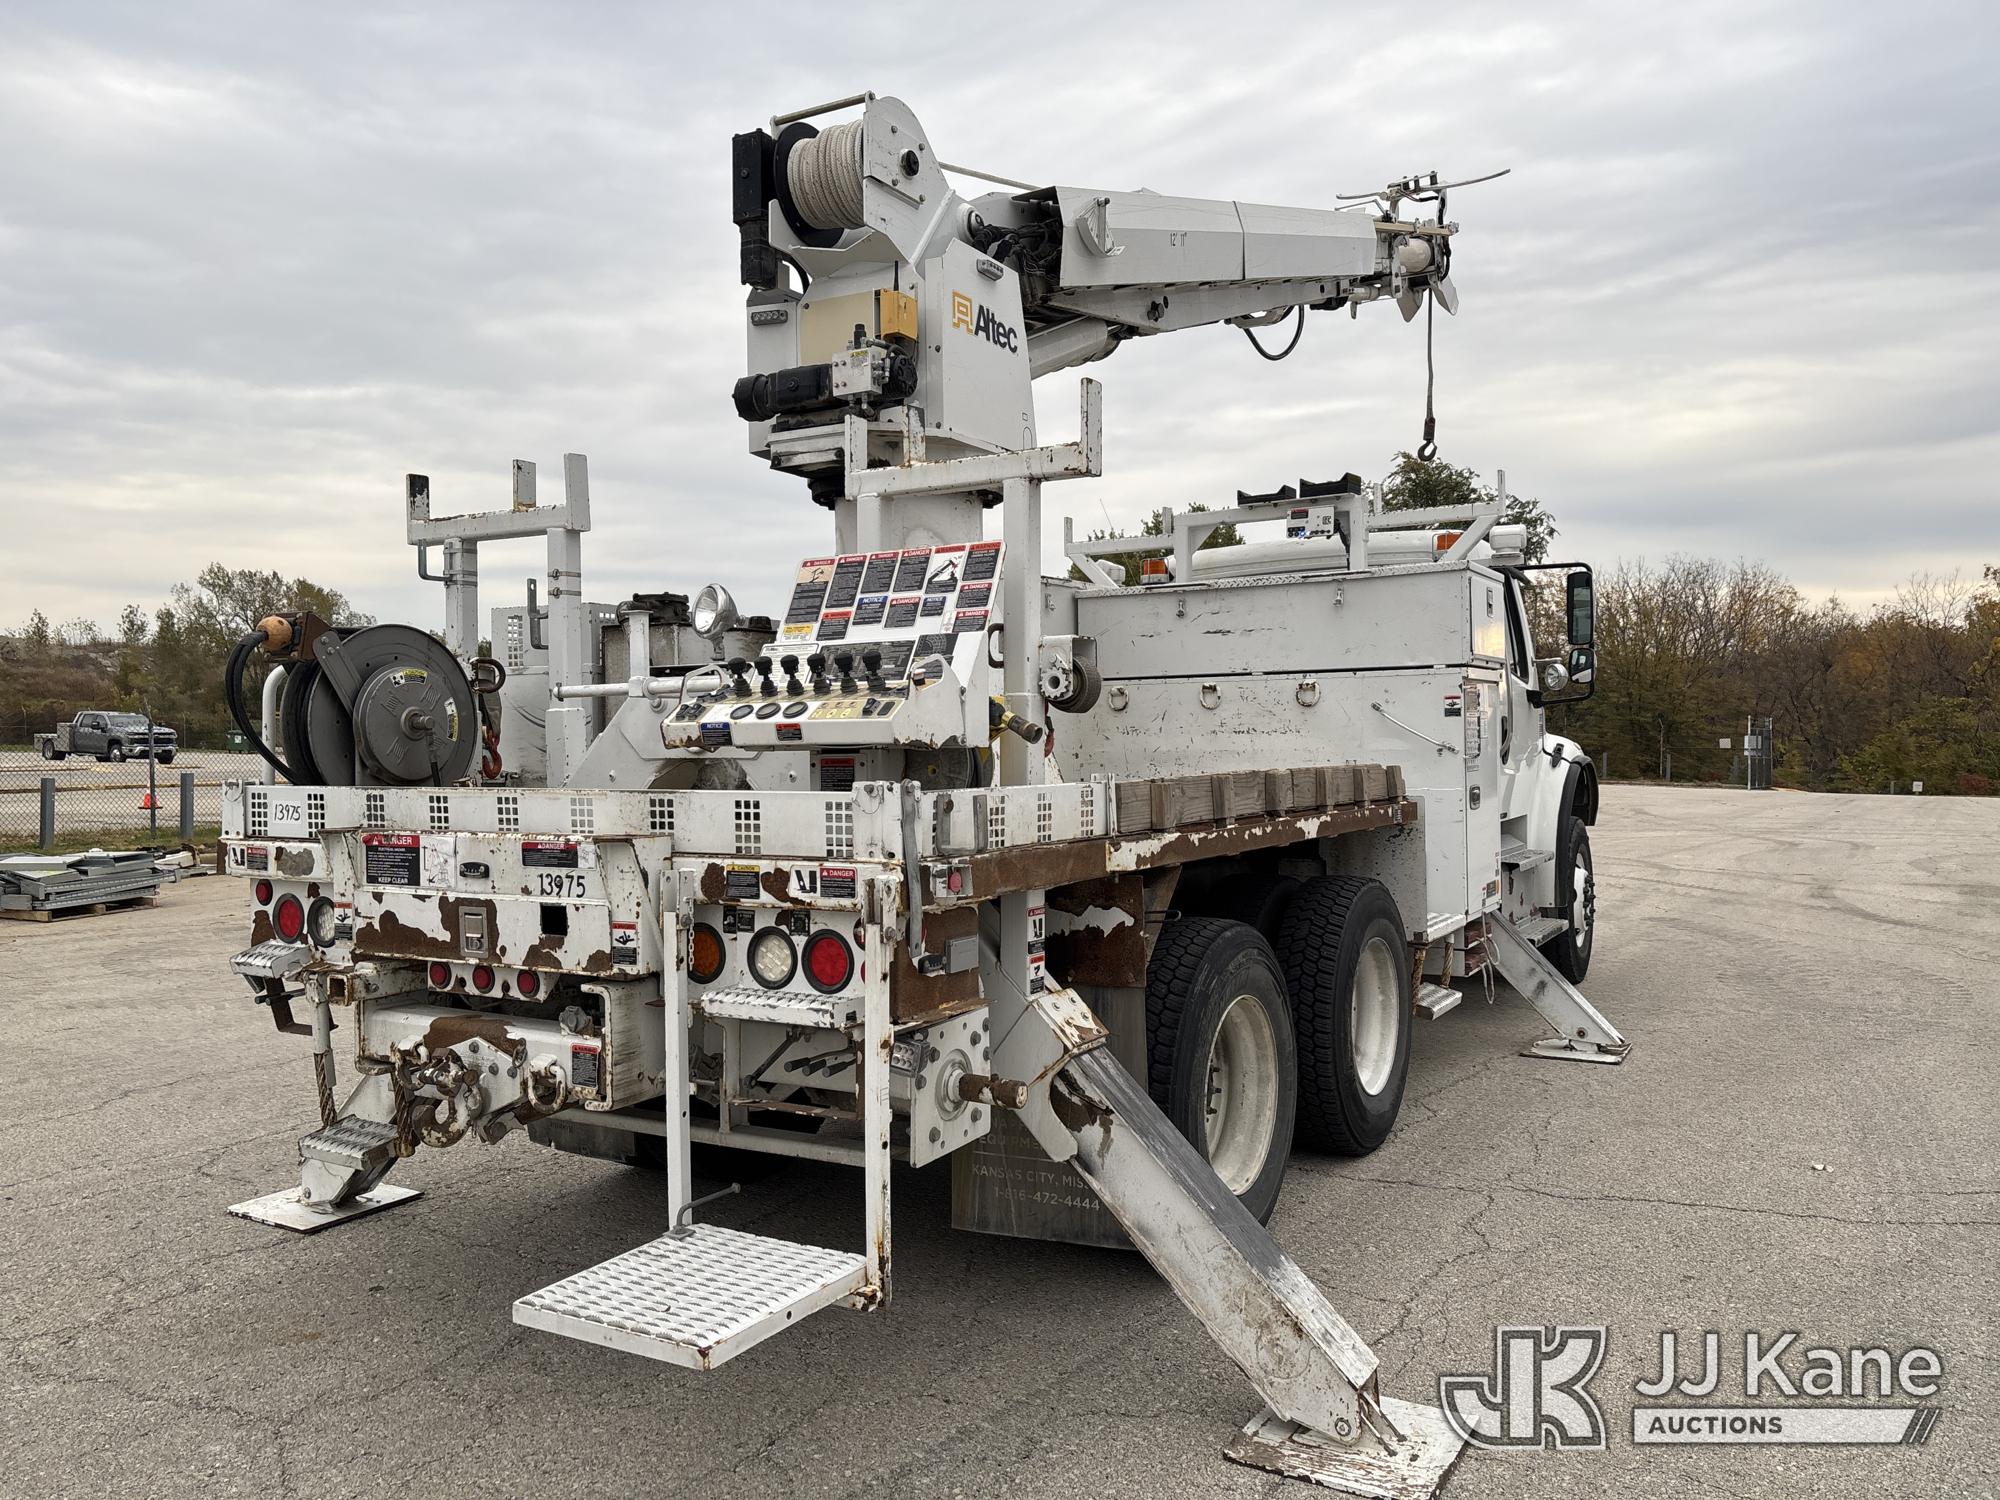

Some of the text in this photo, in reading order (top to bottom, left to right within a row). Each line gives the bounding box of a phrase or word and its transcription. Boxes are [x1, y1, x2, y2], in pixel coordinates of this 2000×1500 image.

[974, 304, 1018, 354] Altec
[908, 549, 930, 557] DANGER
[274, 803, 301, 821] 13975
[541, 842, 565, 850] DANGER
[829, 869, 854, 877] DANGER
[537, 872, 586, 899] 13975
[979, 1133, 1043, 1151] EQUIPME
[973, 1163, 1022, 1181] KANSAS
[1026, 1170, 1059, 1187] CITY,
[993, 1186, 1101, 1212] 1-816-472-4444
